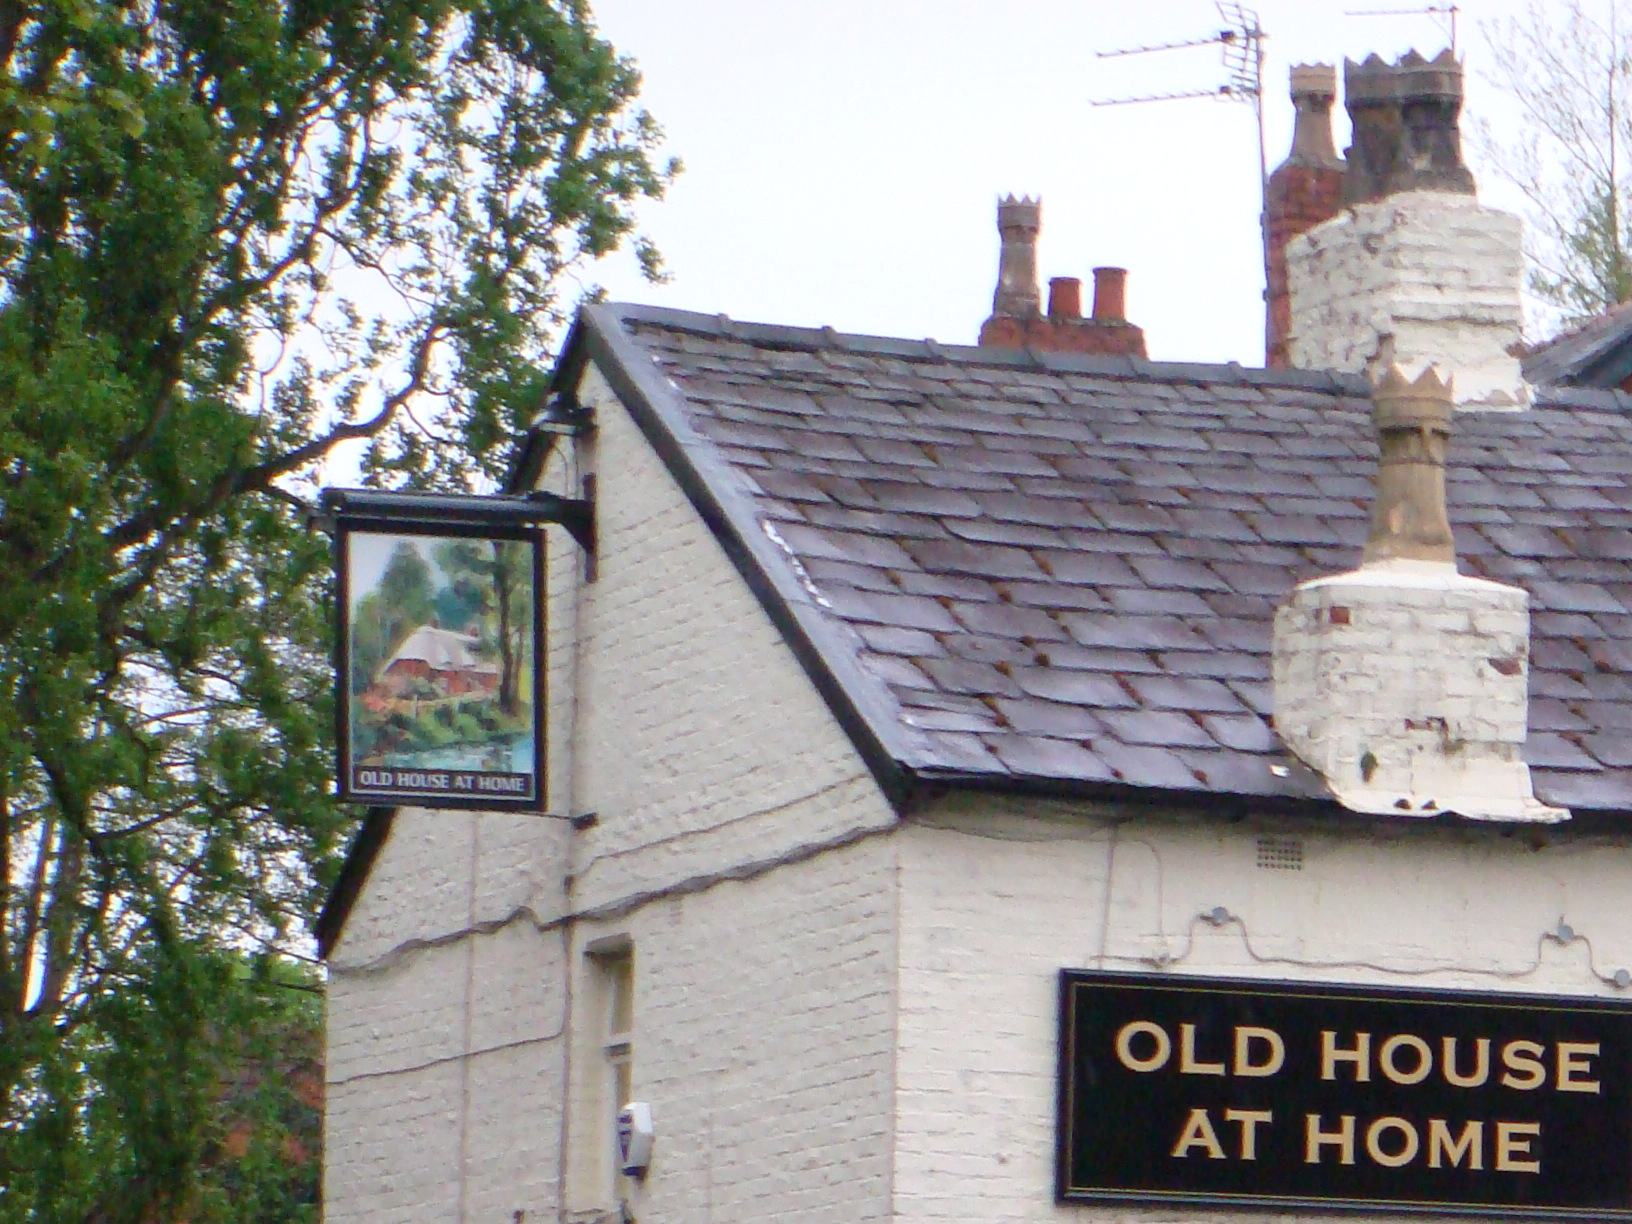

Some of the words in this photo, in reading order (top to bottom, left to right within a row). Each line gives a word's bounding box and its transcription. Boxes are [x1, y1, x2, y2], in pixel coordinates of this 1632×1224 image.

[360, 771, 393, 787] OLD
[397, 772, 450, 789] HOUSE
[455, 775, 475, 789] AT
[479, 777, 525, 792] HOME
[1115, 1021, 1285, 1078] OLD
[1320, 1030, 1602, 1095] HOUSE
[1171, 1108, 1273, 1161] AT
[1304, 1113, 1541, 1174] HOME
